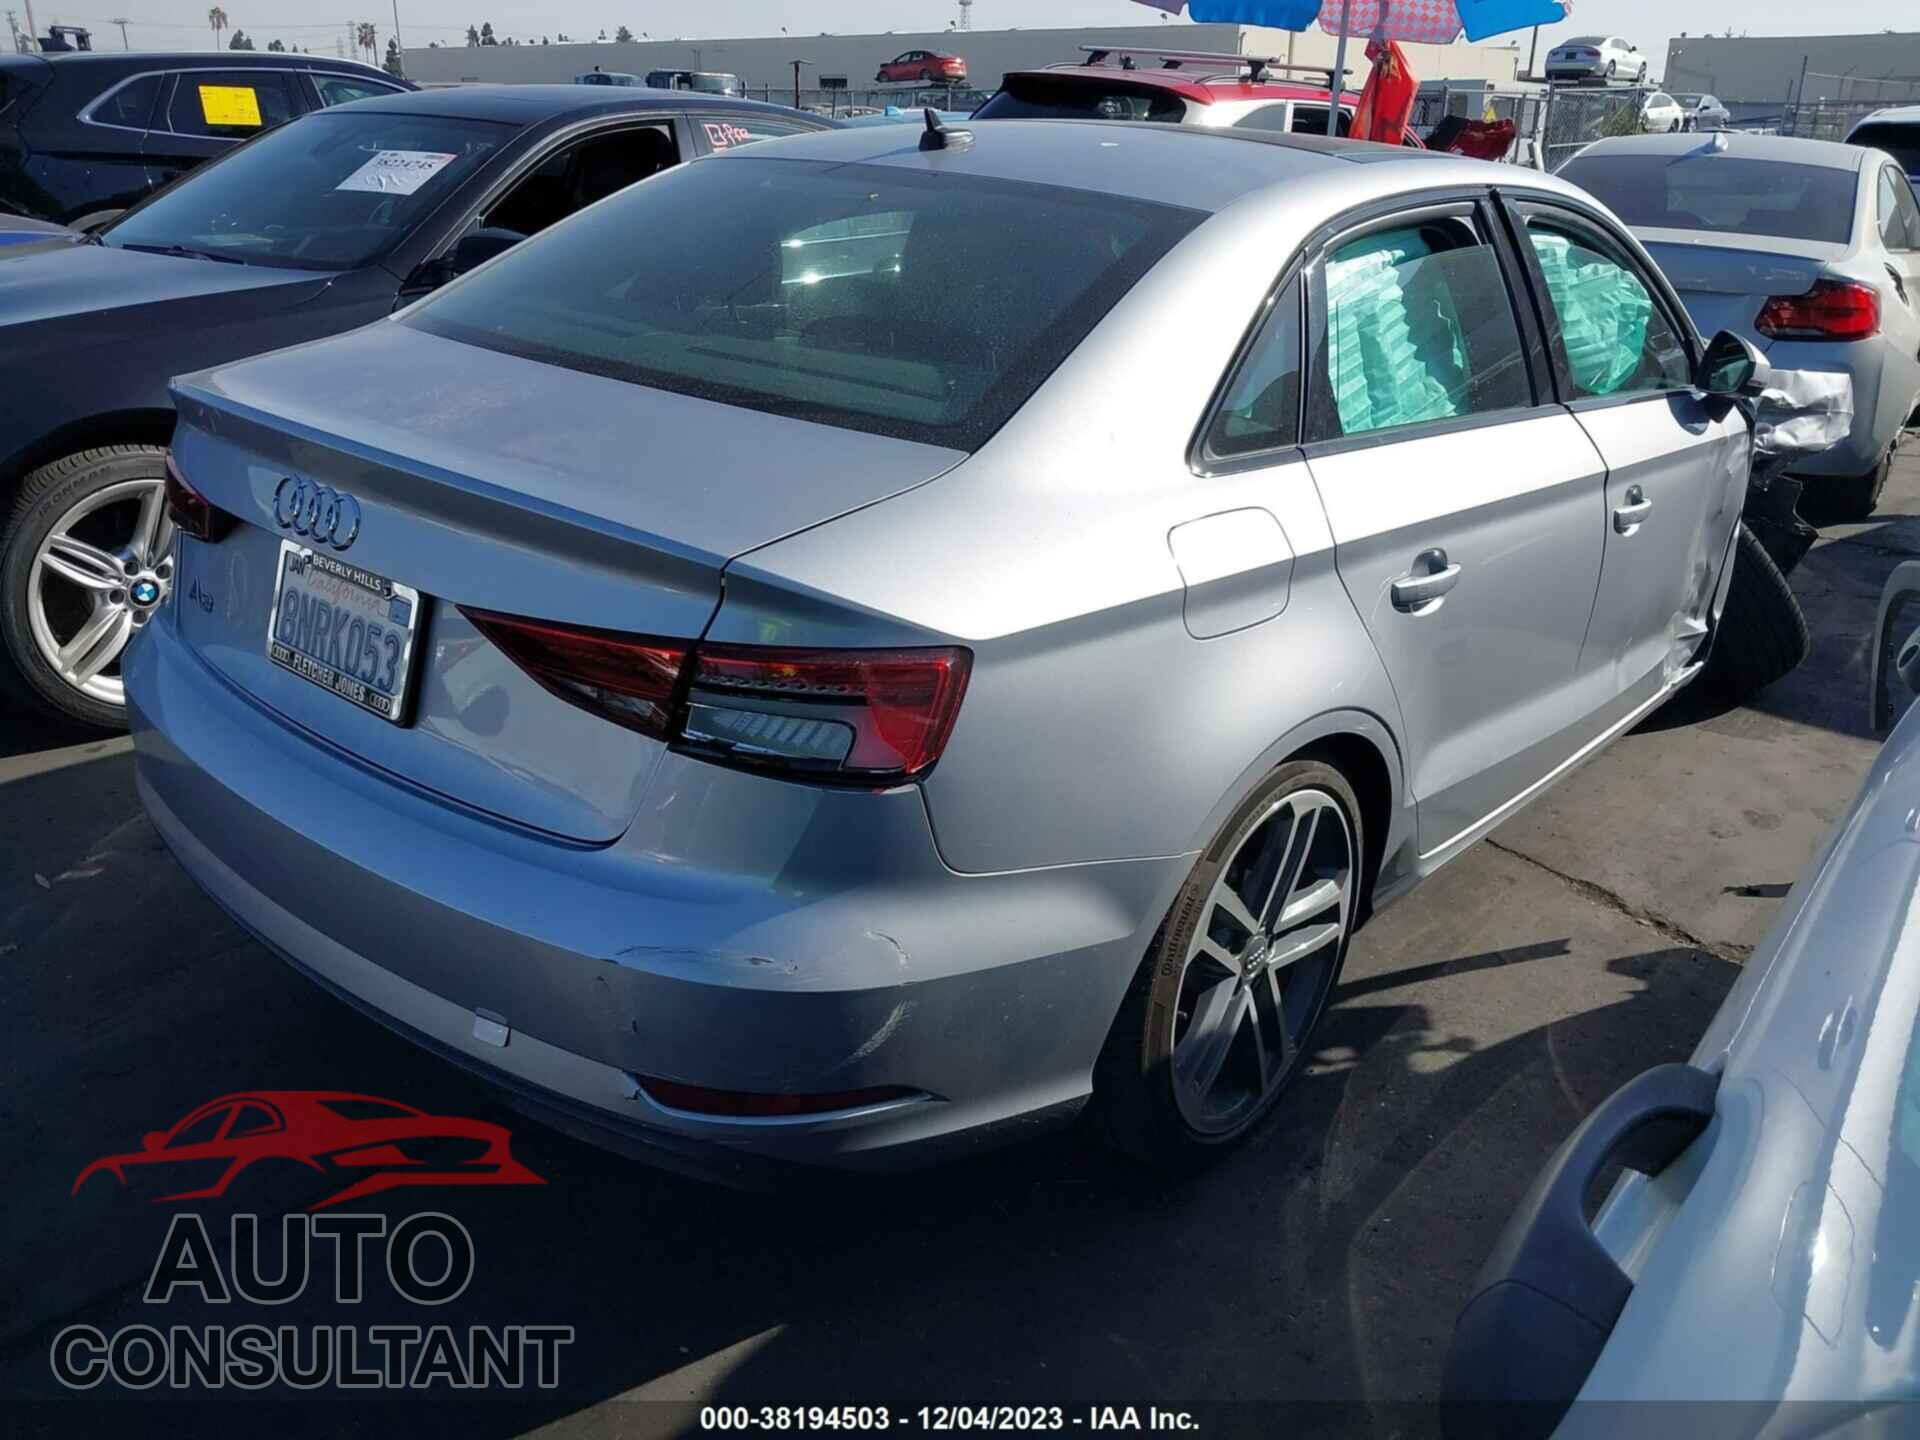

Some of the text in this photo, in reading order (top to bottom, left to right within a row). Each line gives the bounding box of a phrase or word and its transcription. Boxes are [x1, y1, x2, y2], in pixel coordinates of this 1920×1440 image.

[312, 553, 382, 591] BEVERLY HILLS
[278, 586, 401, 693] 8NRK053
[292, 652, 368, 702] FLETCHER JONES
